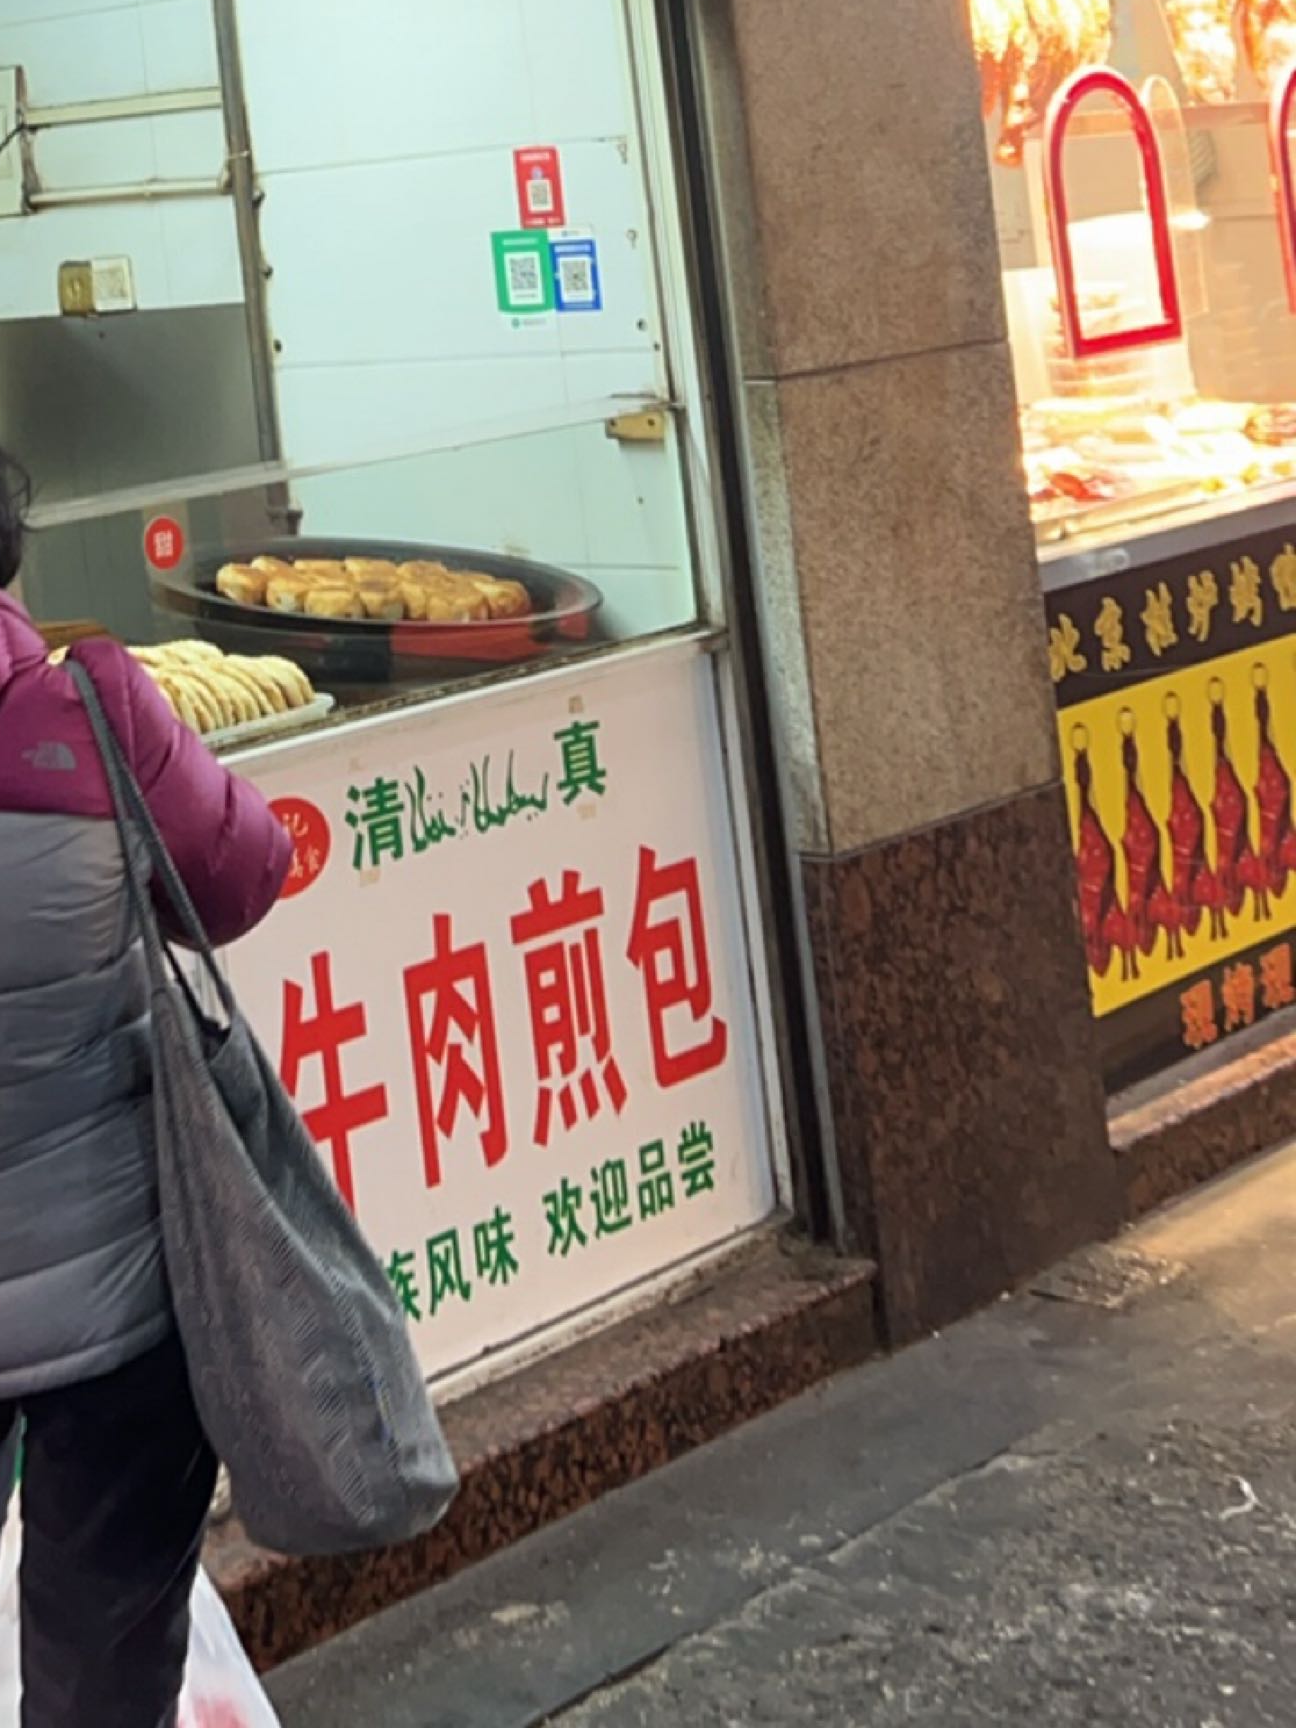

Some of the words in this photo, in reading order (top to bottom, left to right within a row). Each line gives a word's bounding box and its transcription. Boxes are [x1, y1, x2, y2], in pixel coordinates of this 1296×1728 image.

[347, 777, 406, 872] 清
[554, 721, 607, 804] 真
[279, 845, 728, 1220] 牛肉煎包
[544, 1120, 716, 1258] 欢迎品尝
